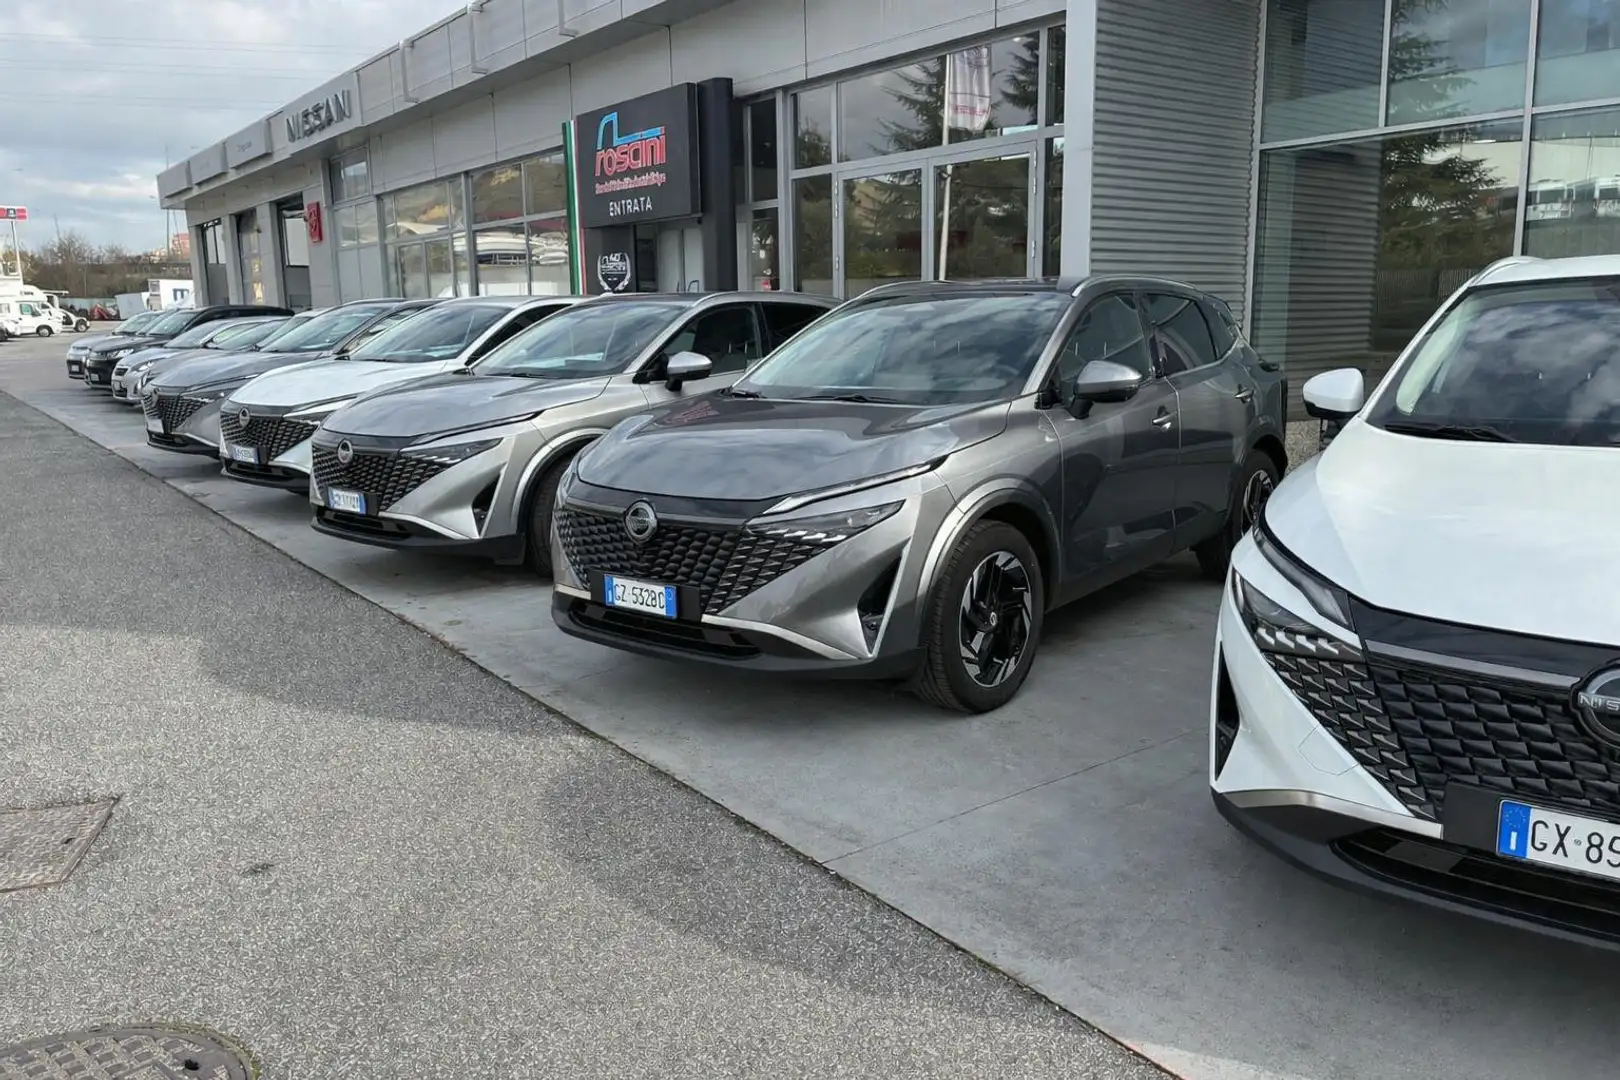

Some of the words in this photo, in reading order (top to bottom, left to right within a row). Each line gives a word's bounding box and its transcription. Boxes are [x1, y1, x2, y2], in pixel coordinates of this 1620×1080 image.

[286, 88, 351, 143] NISSAN
[609, 196, 653, 217] ENTRATA
[1531, 820, 1572, 858] GX
